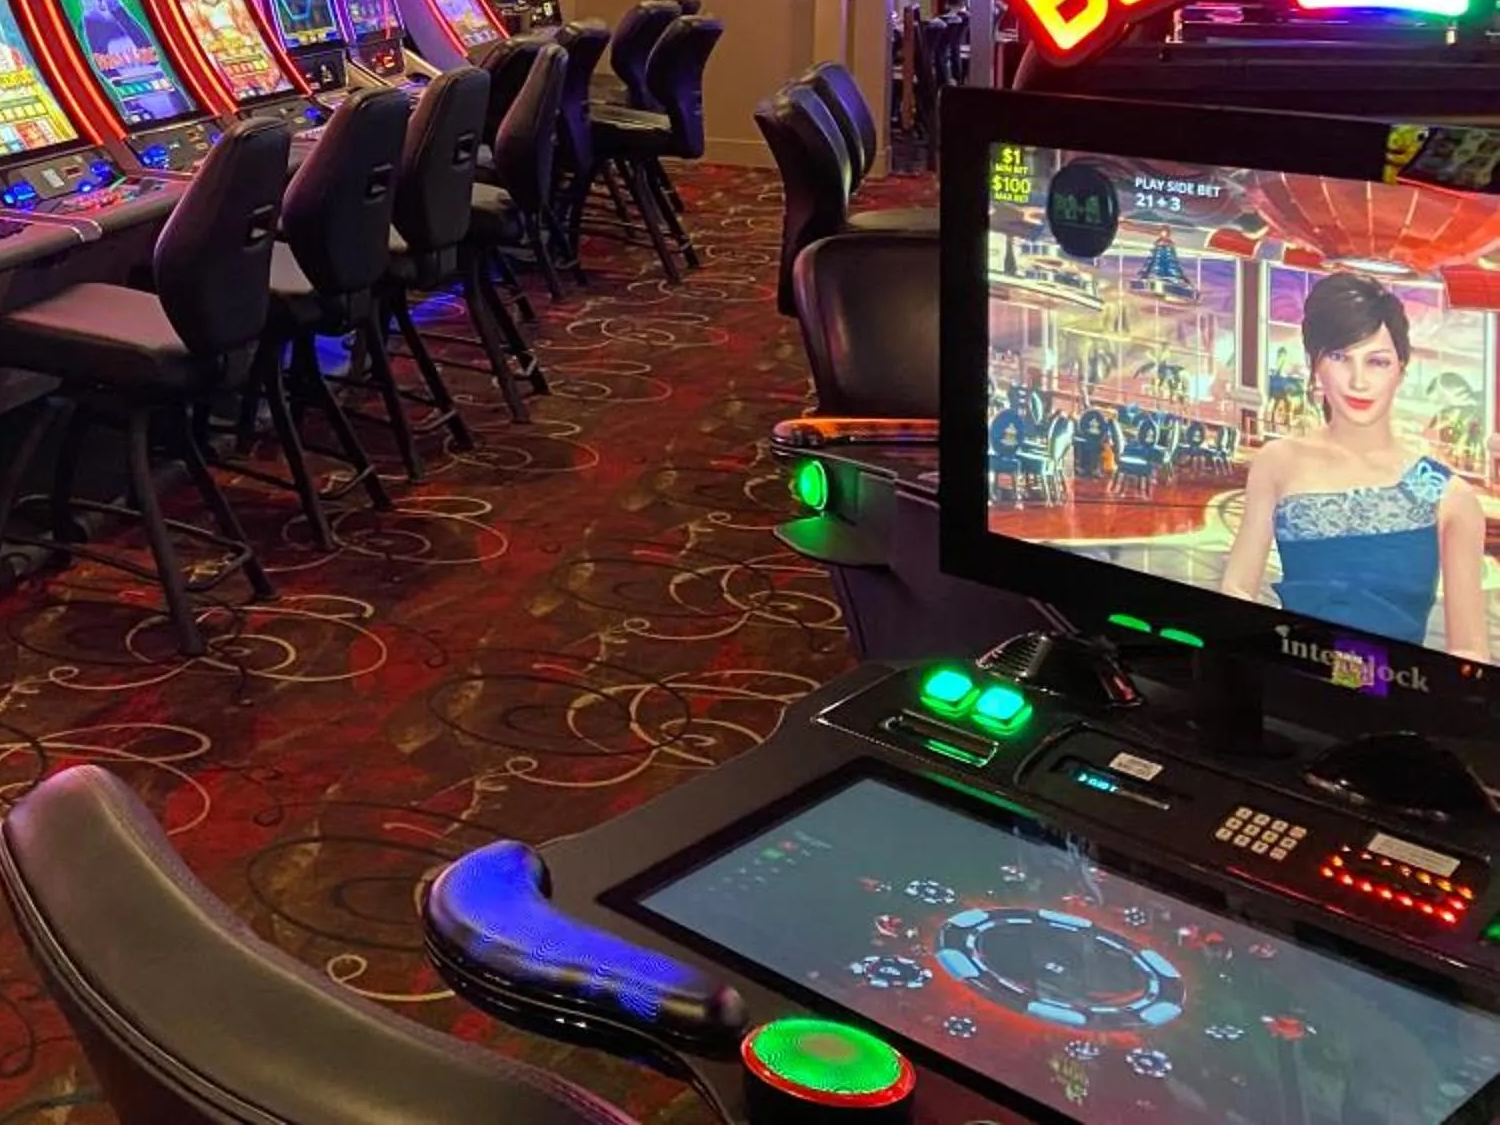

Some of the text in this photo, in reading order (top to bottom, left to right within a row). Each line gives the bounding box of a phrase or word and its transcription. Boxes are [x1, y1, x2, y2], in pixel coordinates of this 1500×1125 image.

[1002, 148, 1021, 165] $1
[991, 175, 1031, 194] $100
[1135, 177, 1221, 198] PLAY SIDE BET
[1134, 193, 1154, 209] 21
